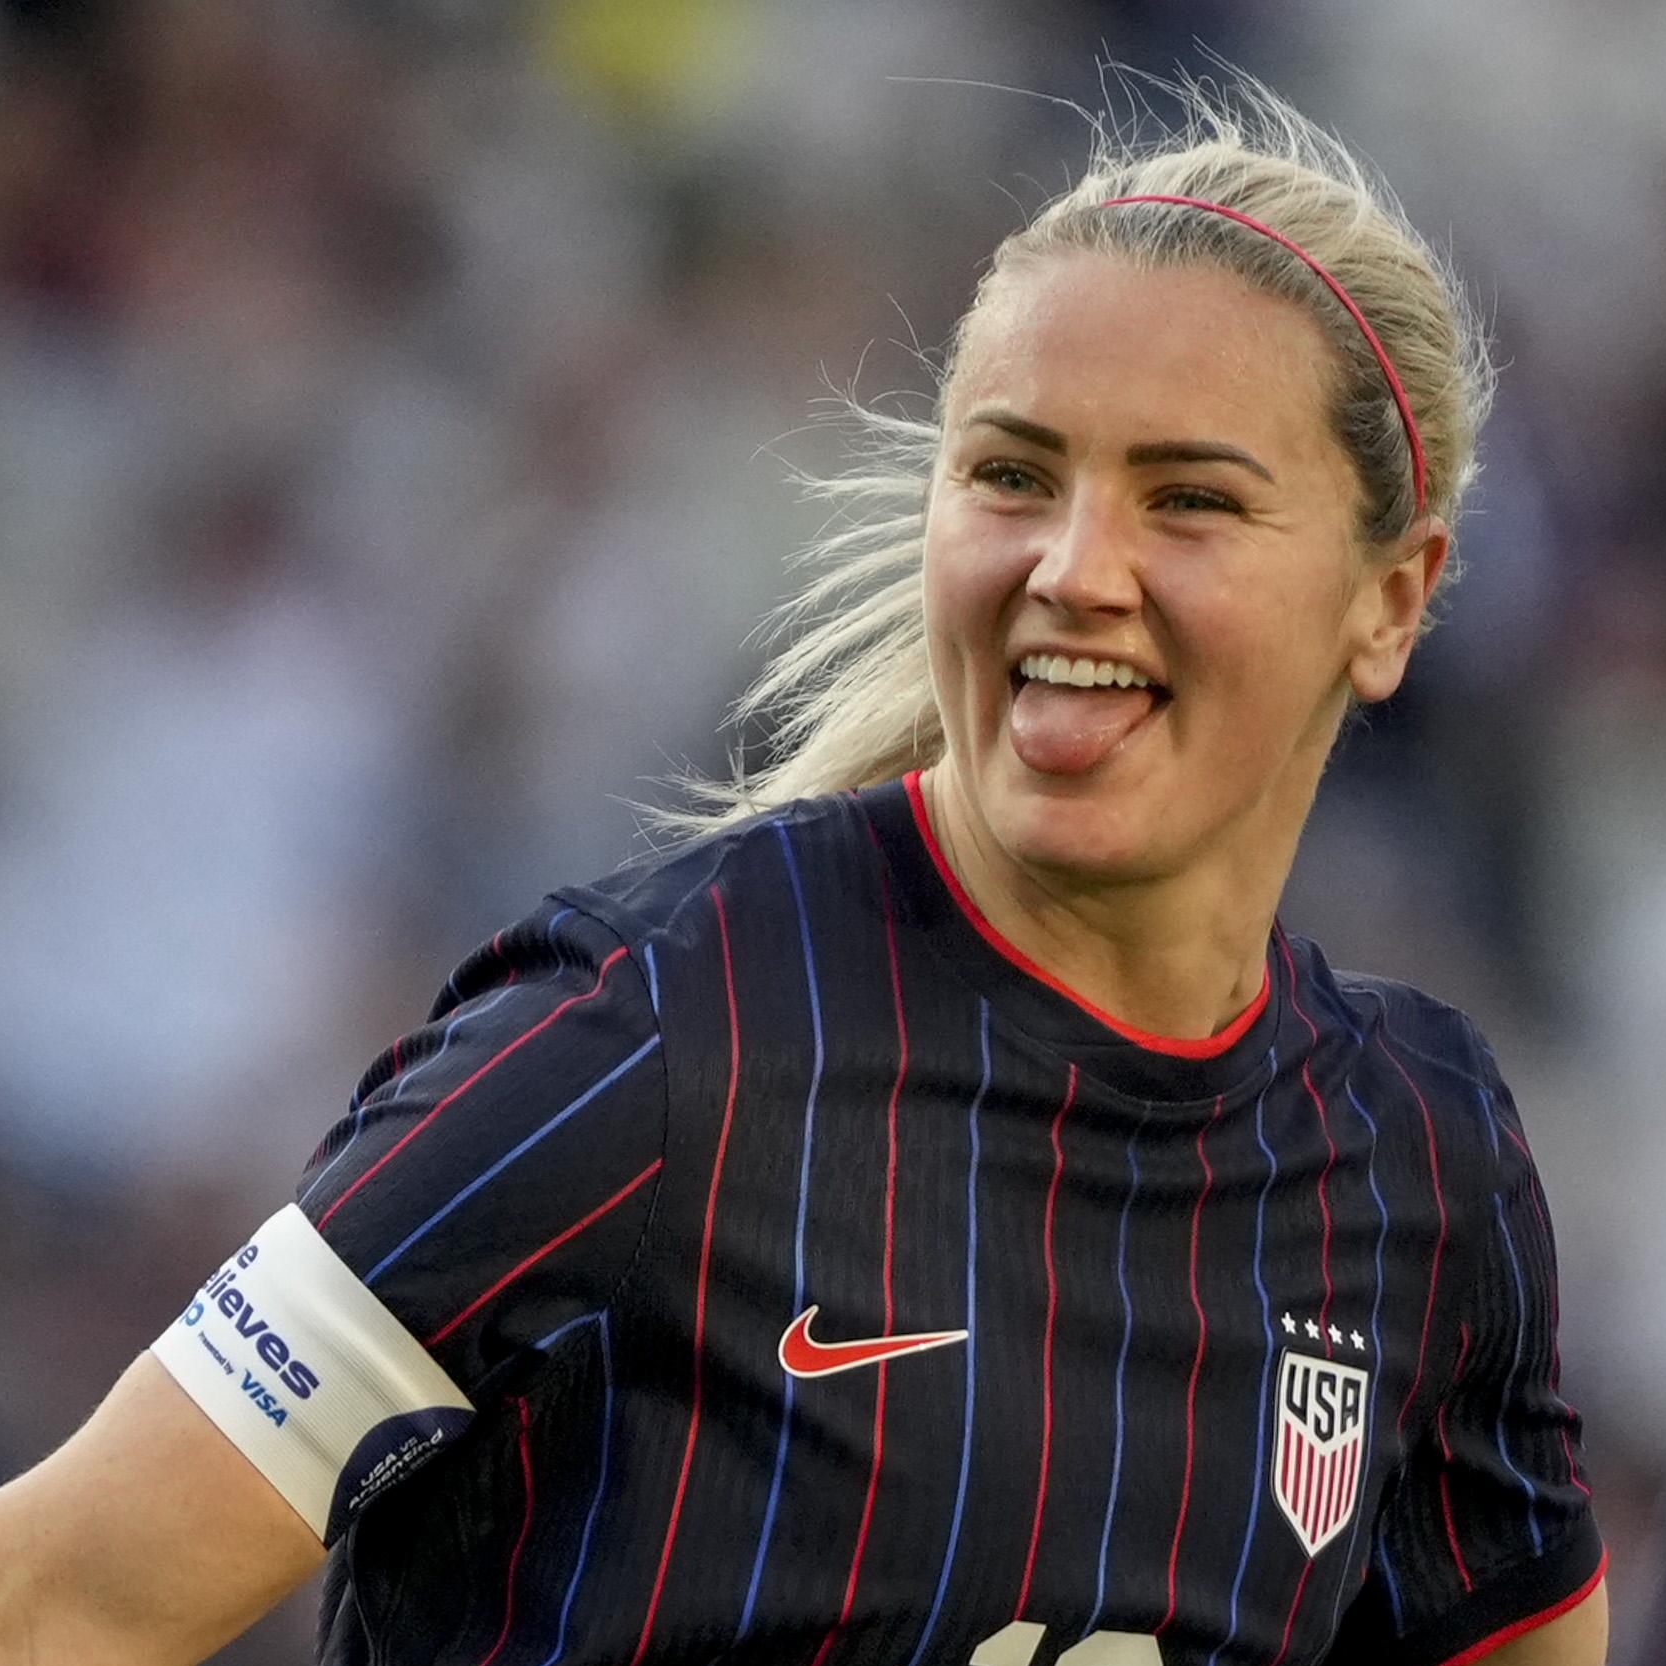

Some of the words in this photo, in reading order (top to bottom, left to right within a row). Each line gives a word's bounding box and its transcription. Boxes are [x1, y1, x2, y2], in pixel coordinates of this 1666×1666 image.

[241, 1367, 290, 1428] VISA
[1285, 1362, 1362, 1443] USA
[360, 1453, 398, 1487] USA
